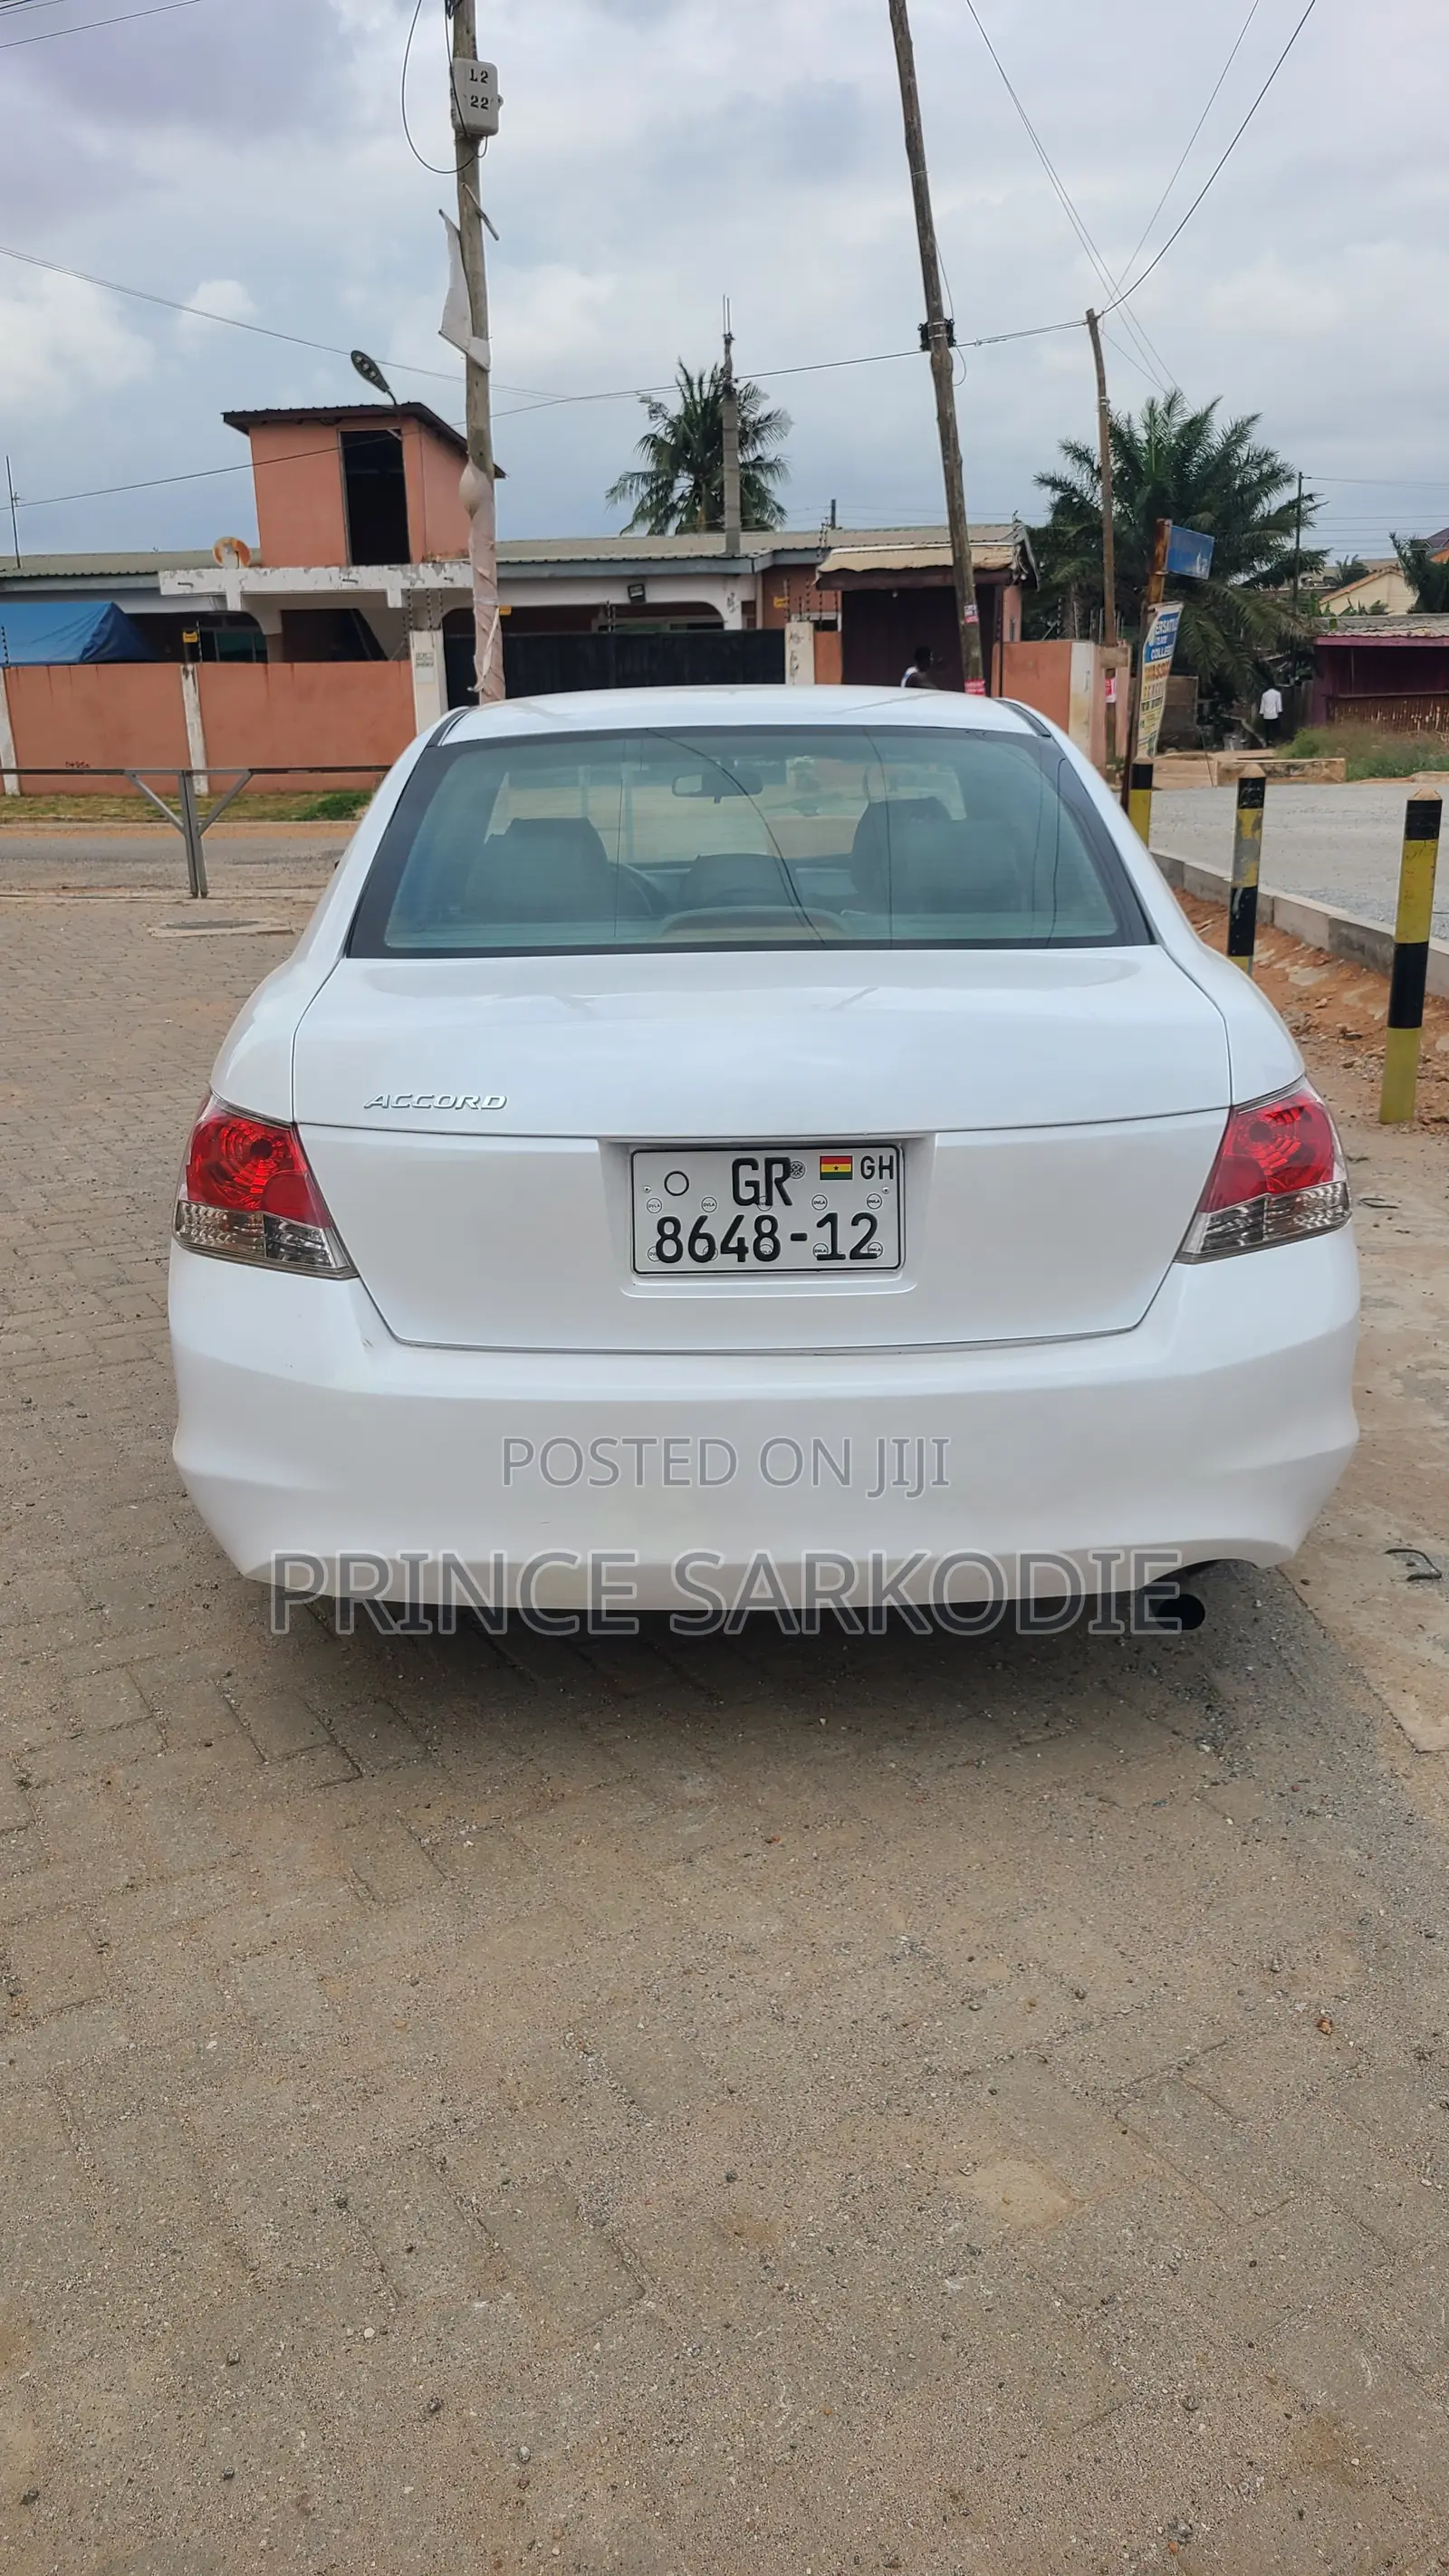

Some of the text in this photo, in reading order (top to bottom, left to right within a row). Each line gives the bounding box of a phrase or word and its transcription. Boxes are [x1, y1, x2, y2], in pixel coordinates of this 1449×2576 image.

[470, 94, 489, 110] 22
[363, 1093, 508, 1111] ACCORD
[860, 1155, 894, 1180] GH
[731, 1156, 792, 1206] GR
[655, 1211, 879, 1264] 8648-12
